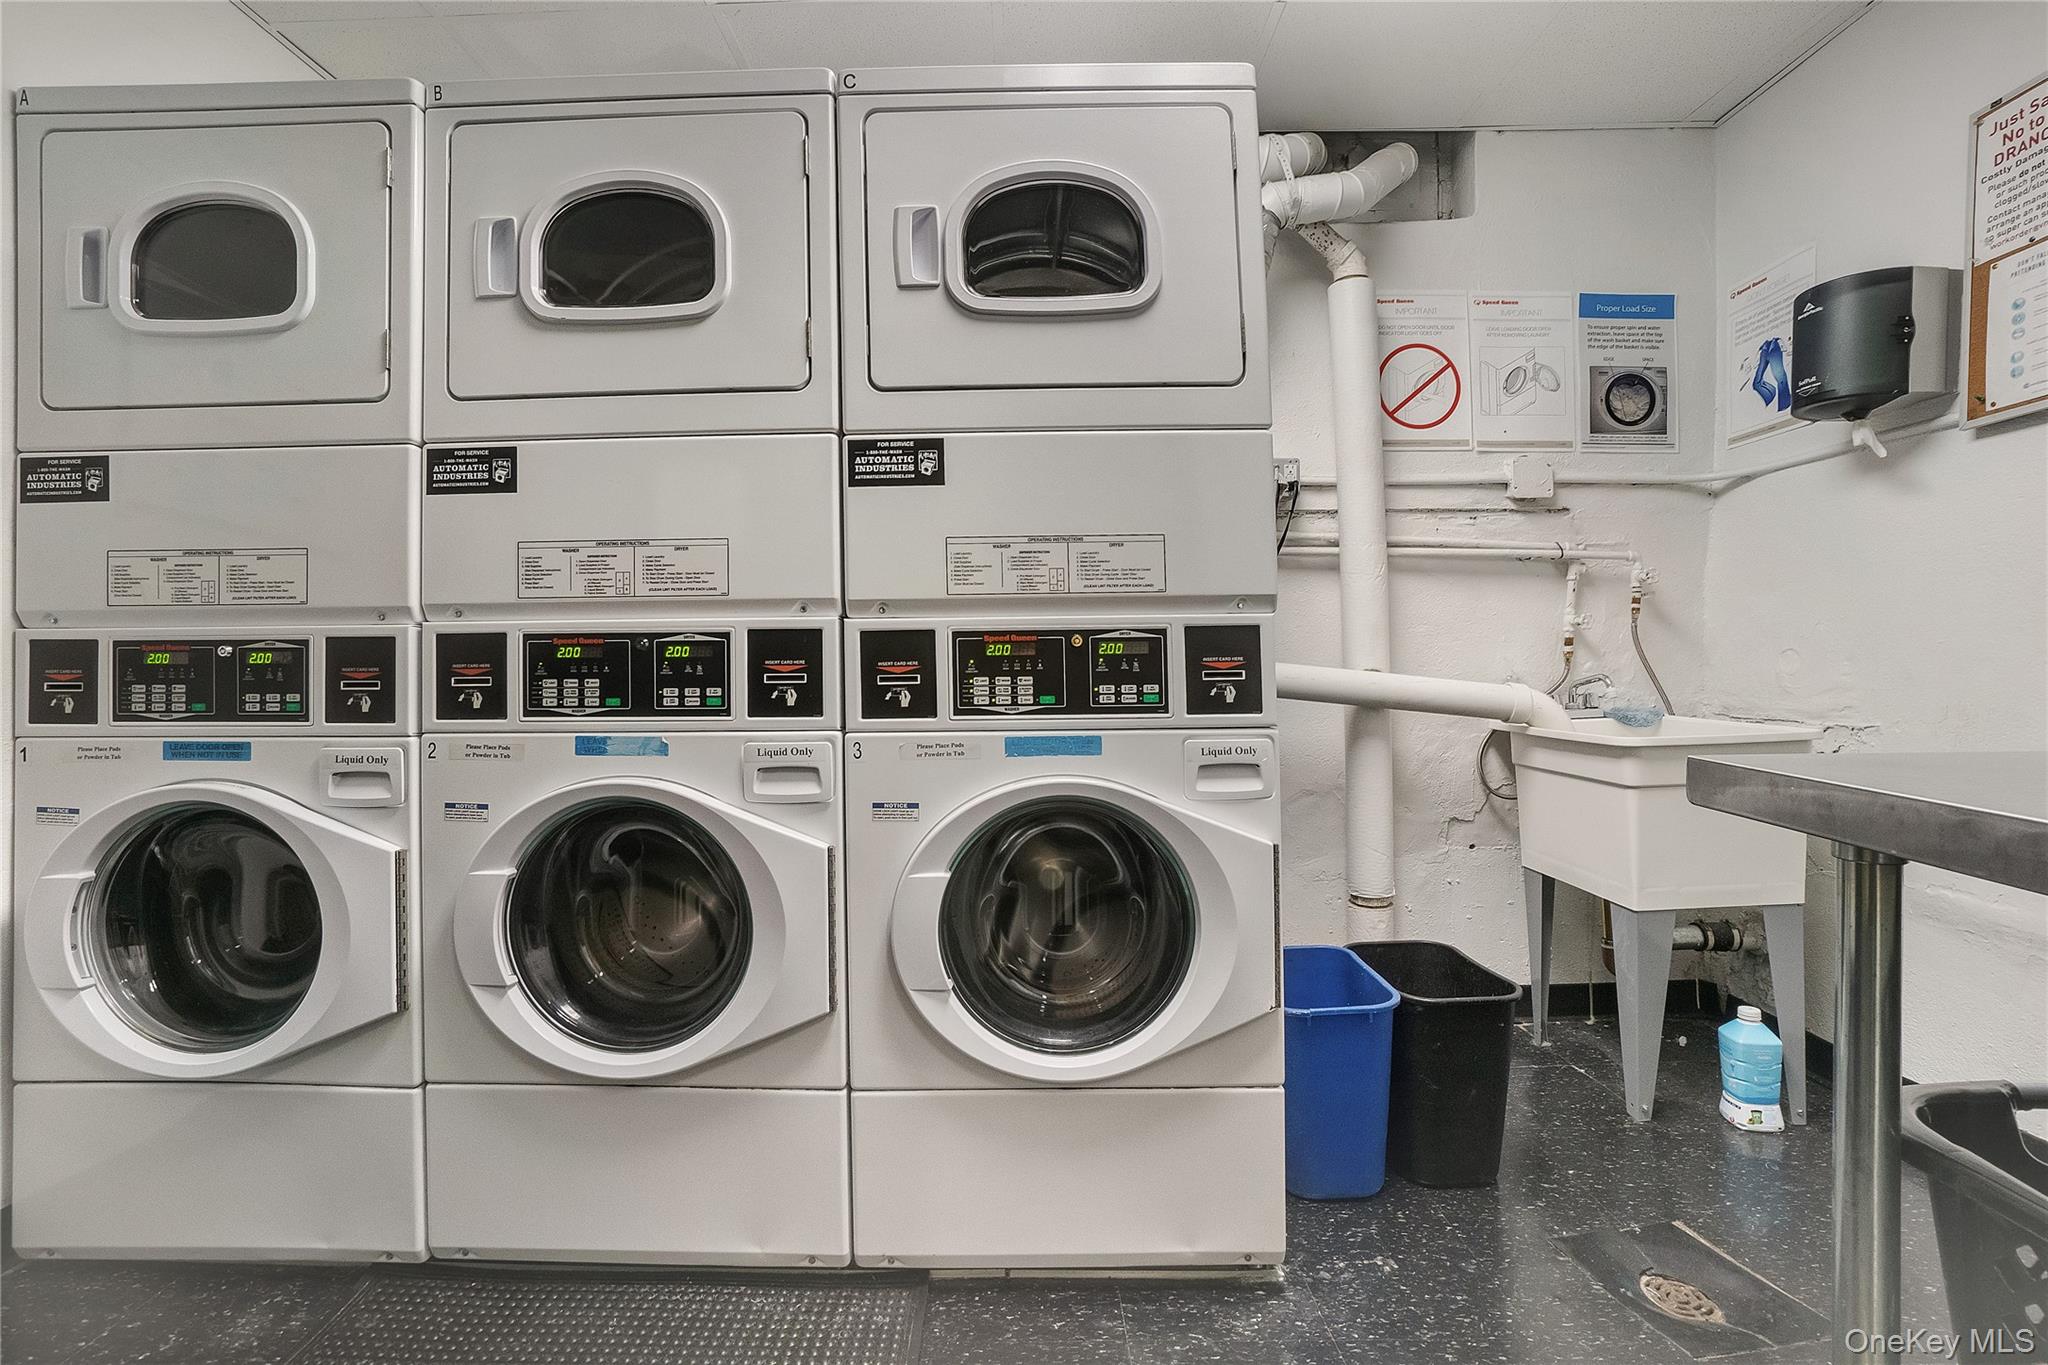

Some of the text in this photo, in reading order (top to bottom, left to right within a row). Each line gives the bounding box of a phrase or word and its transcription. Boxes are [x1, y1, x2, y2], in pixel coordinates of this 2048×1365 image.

[843, 73, 856, 89] C
[20, 89, 29, 106] A
[434, 85, 443, 101] B
[1989, 108, 2025, 137] Just
[2003, 116, 2045, 146] No to
[1981, 165, 2013, 184] Costly
[1988, 160, 2046, 193] Please do not
[1996, 190, 2006, 199] or
[2007, 179, 2028, 193] such
[1987, 191, 2048, 224] Contact mana
[1986, 214, 2021, 234] arrange
[2023, 207, 2034, 217] an
[1996, 222, 2022, 239] super
[2023, 214, 2039, 226] can
[1395, 307, 1437, 315] IMPORTANT
[1596, 304, 1657, 313] Proper Load Size
[854, 455, 915, 464] AUTOMATIC
[432, 463, 489, 473] AUTOMATIC
[854, 464, 915, 473] INDUSTRIES
[26, 472, 82, 481] AUTOMATIC
[432, 472, 489, 481] INDUSTRIES
[26, 481, 82, 489] INDUSTRIES
[557, 647, 581, 658] 2.00
[665, 646, 690, 657] 2.00
[986, 645, 1011, 656] 2.00
[1099, 643, 1123, 655] 2.00
[147, 653, 170, 665] 2.00
[249, 652, 272, 664] 2.00
[169, 743, 244, 751] LEAVE DOOR OPEN
[427, 742, 437, 759] 2
[466, 743, 511, 751] Please Place Pods
[852, 741, 862, 759] 3
[916, 742, 965, 750] Please Place Pods
[20, 747, 27, 763] 1
[171, 751, 241, 759] WHEN NOT IN USE
[757, 747, 814, 758] Liquid Only
[916, 750, 965, 758] or Powder in Tub
[1201, 746, 1258, 758] Liquid Only
[335, 755, 389, 766] Liquid Only
